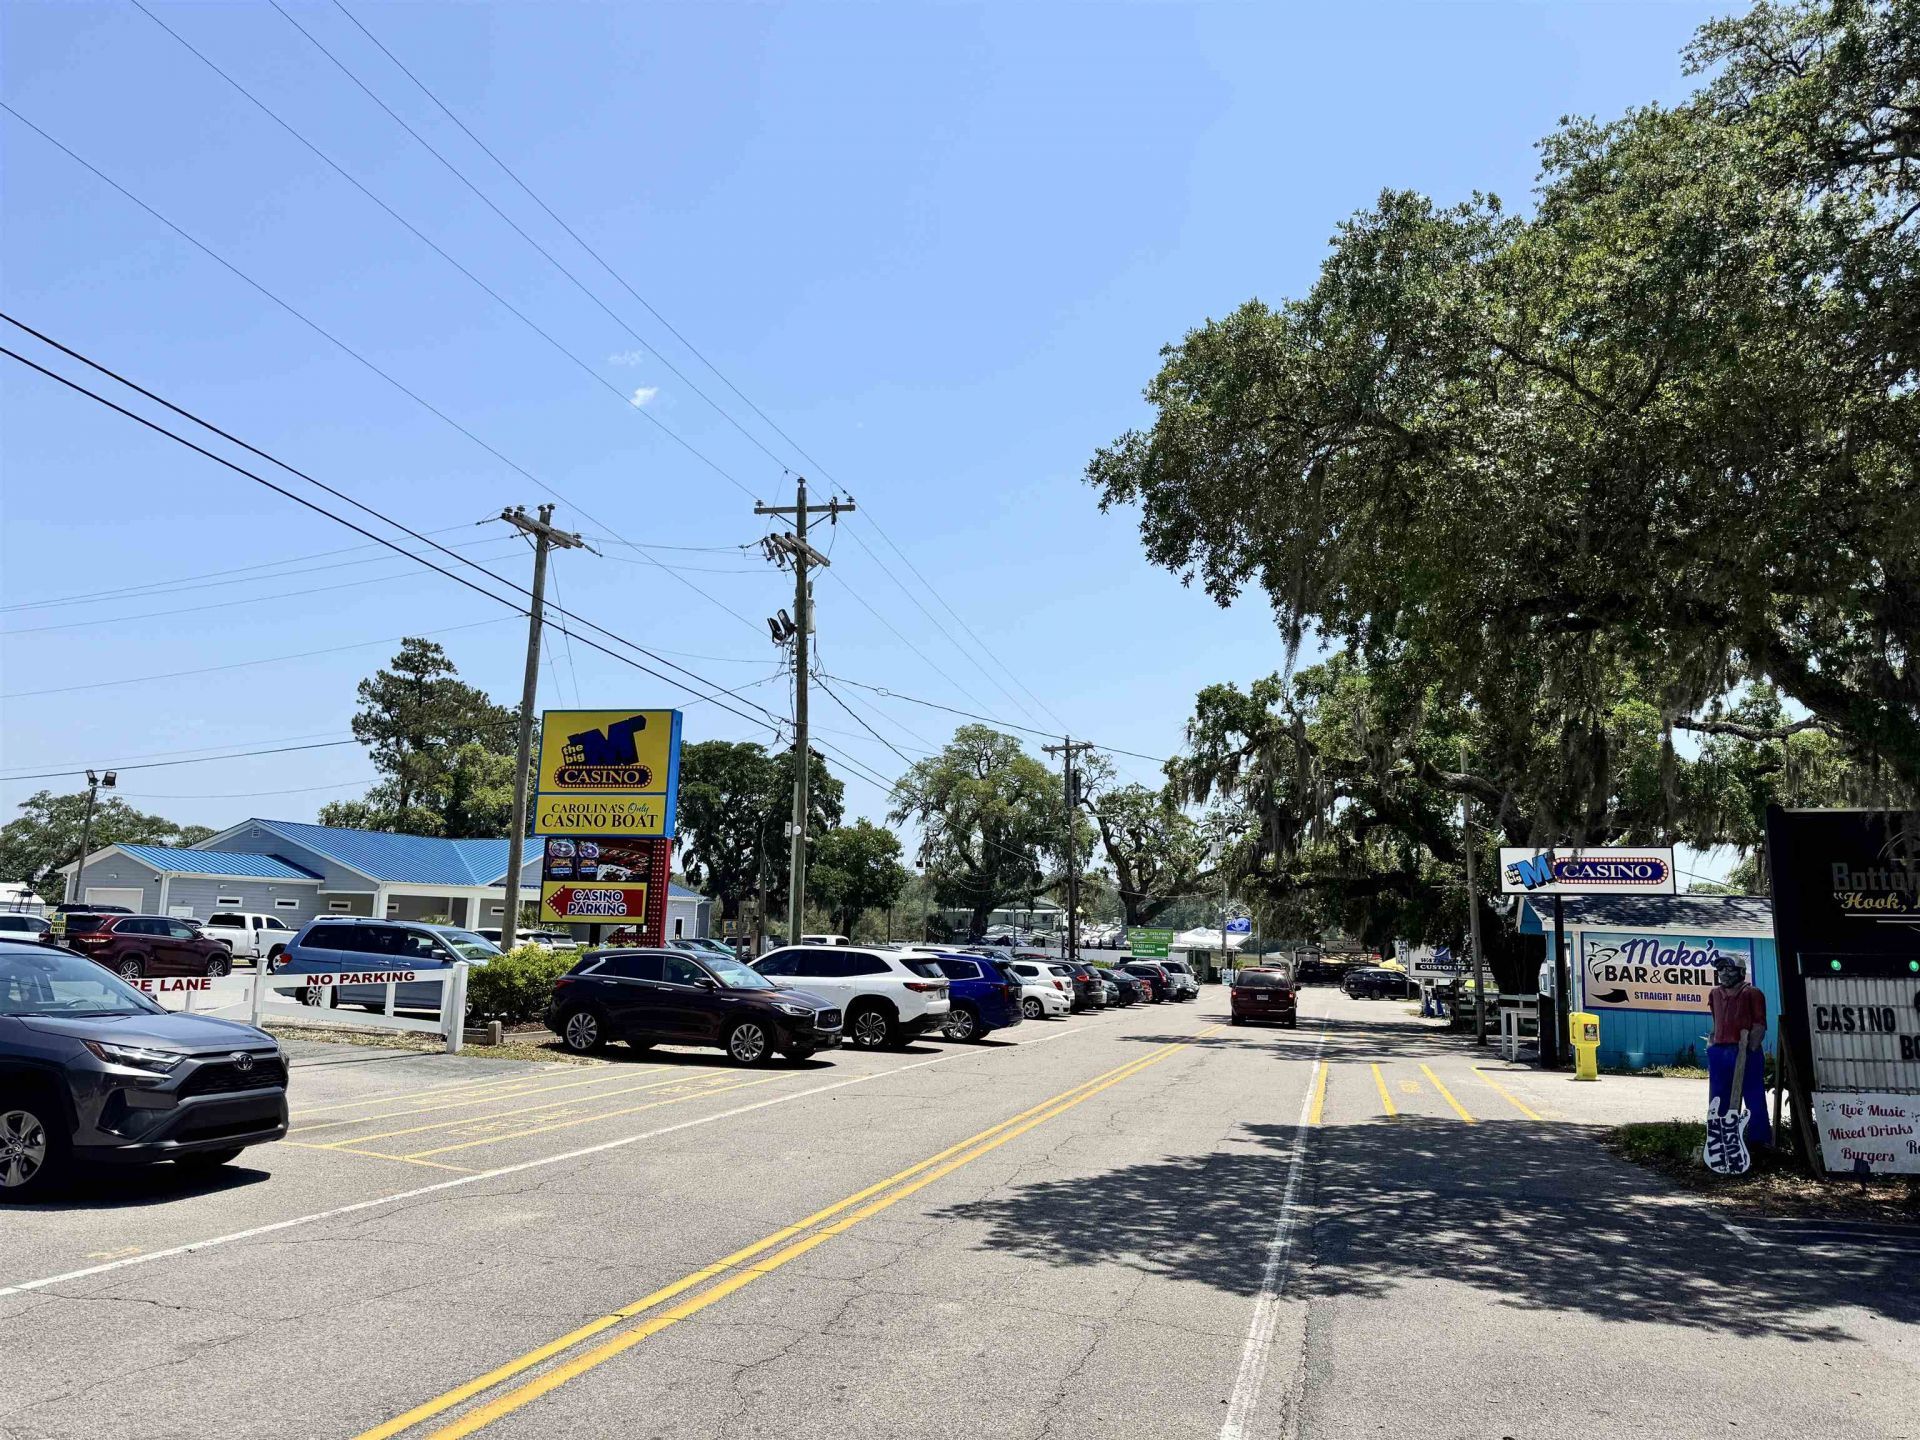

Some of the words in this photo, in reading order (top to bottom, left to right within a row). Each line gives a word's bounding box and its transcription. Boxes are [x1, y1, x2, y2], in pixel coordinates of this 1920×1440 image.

[562, 744, 584, 755] the
[565, 753, 585, 764] big
[564, 770, 640, 784] CASINO
[551, 803, 625, 814] CAROLINA'S
[628, 802, 650, 816] Only
[542, 813, 607, 828] CASINO
[611, 814, 658, 828] BOAT
[1504, 869, 1519, 878] the
[1562, 864, 1653, 878] CASINO
[1507, 875, 1522, 885] big
[573, 889, 624, 902] CASINO
[567, 902, 627, 915] PARKING
[1620, 938, 1719, 967] Mako's
[160, 978, 212, 992] LANE
[306, 974, 333, 986] NO
[339, 971, 415, 984] PARKING
[1634, 991, 1672, 1001] STRAIGHT
[1676, 993, 1702, 1003] AHEAD
[1816, 1004, 1896, 1032] CASINO
[1839, 1104, 1864, 1118] Live
[1867, 1104, 1906, 1118] Music
[1828, 1126, 1866, 1141] Mixed
[1867, 1123, 1913, 1138] Drinks
[1708, 1118, 1726, 1168] LIVE
[1840, 1147, 1895, 1165] Burgers
